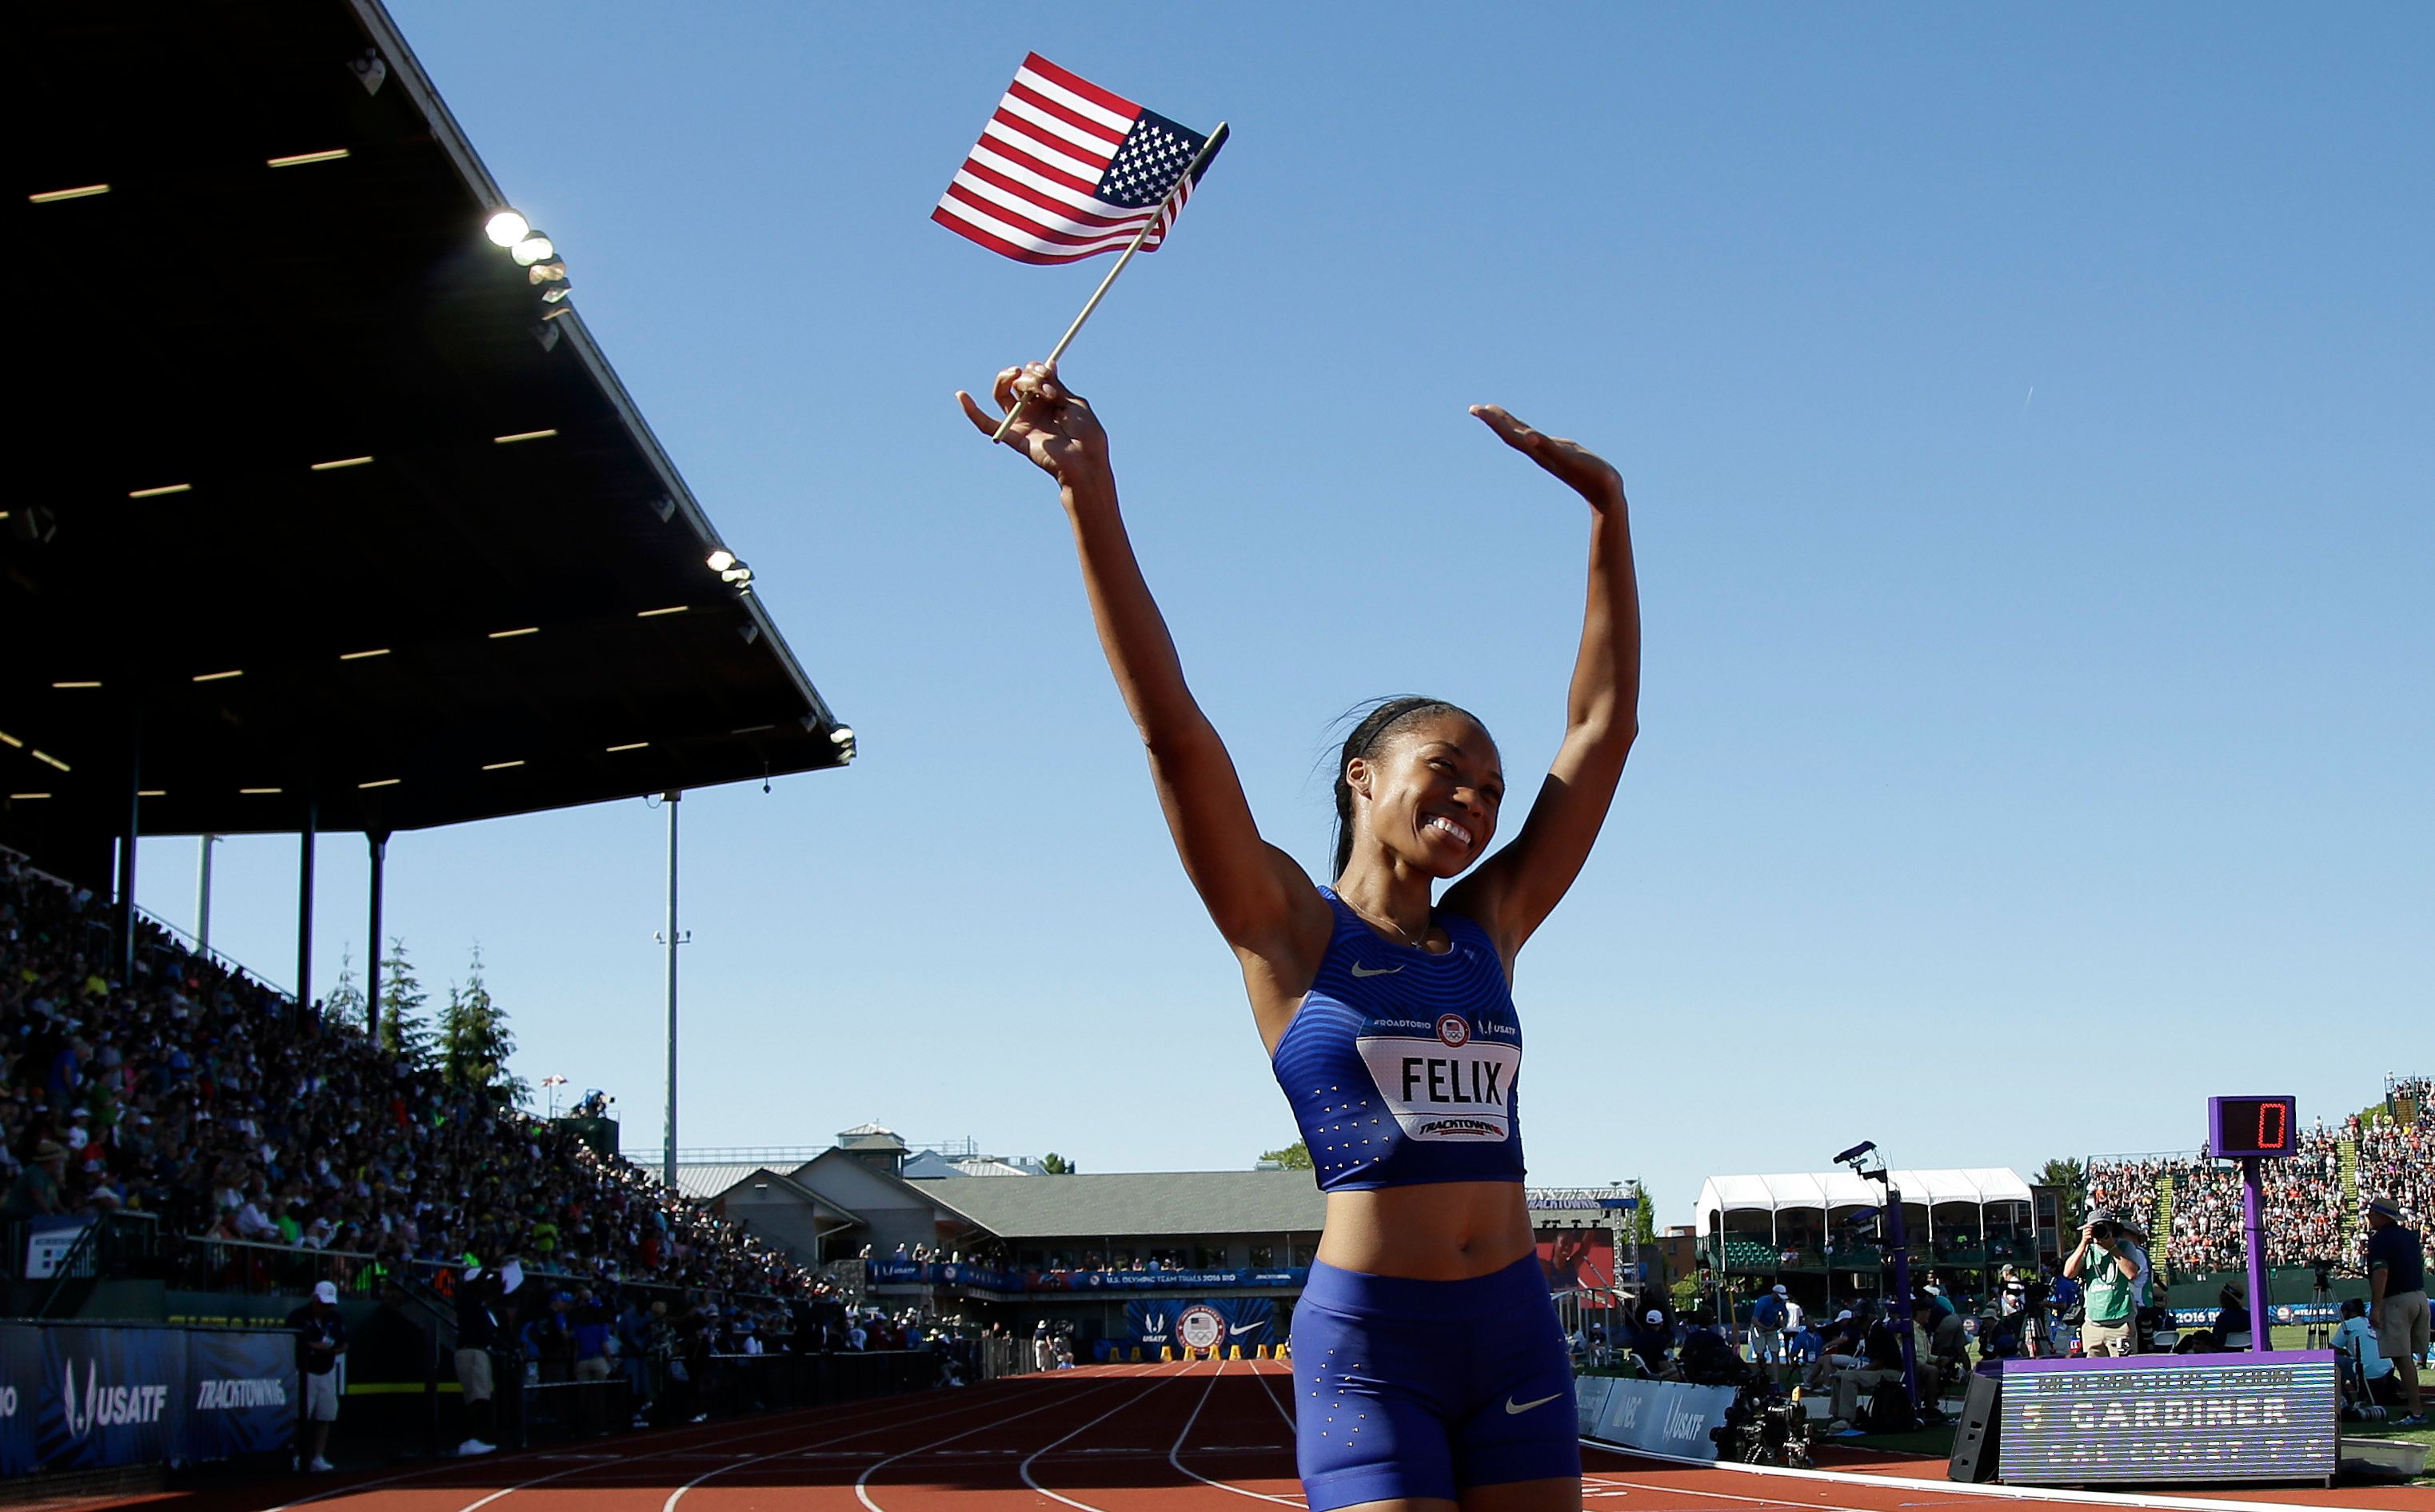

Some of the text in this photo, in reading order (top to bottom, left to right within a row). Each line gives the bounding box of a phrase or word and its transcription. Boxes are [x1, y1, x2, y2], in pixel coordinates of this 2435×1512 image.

[1373, 1019, 1431, 1029] #ROADTORIO
[1494, 1024, 1516, 1035] USATF
[1402, 1057, 1503, 1107] FELIX
[2257, 1102, 2286, 1149] 0
[1528, 1199, 1601, 1210] RACKTOWN16
[2175, 1312, 2205, 1323] 2016
[0, 1386, 18, 1417] IO
[96, 1385, 168, 1426] USATF
[2070, 1396, 2289, 1429] GARDINER
[1671, 1412, 1706, 1441] USATF
